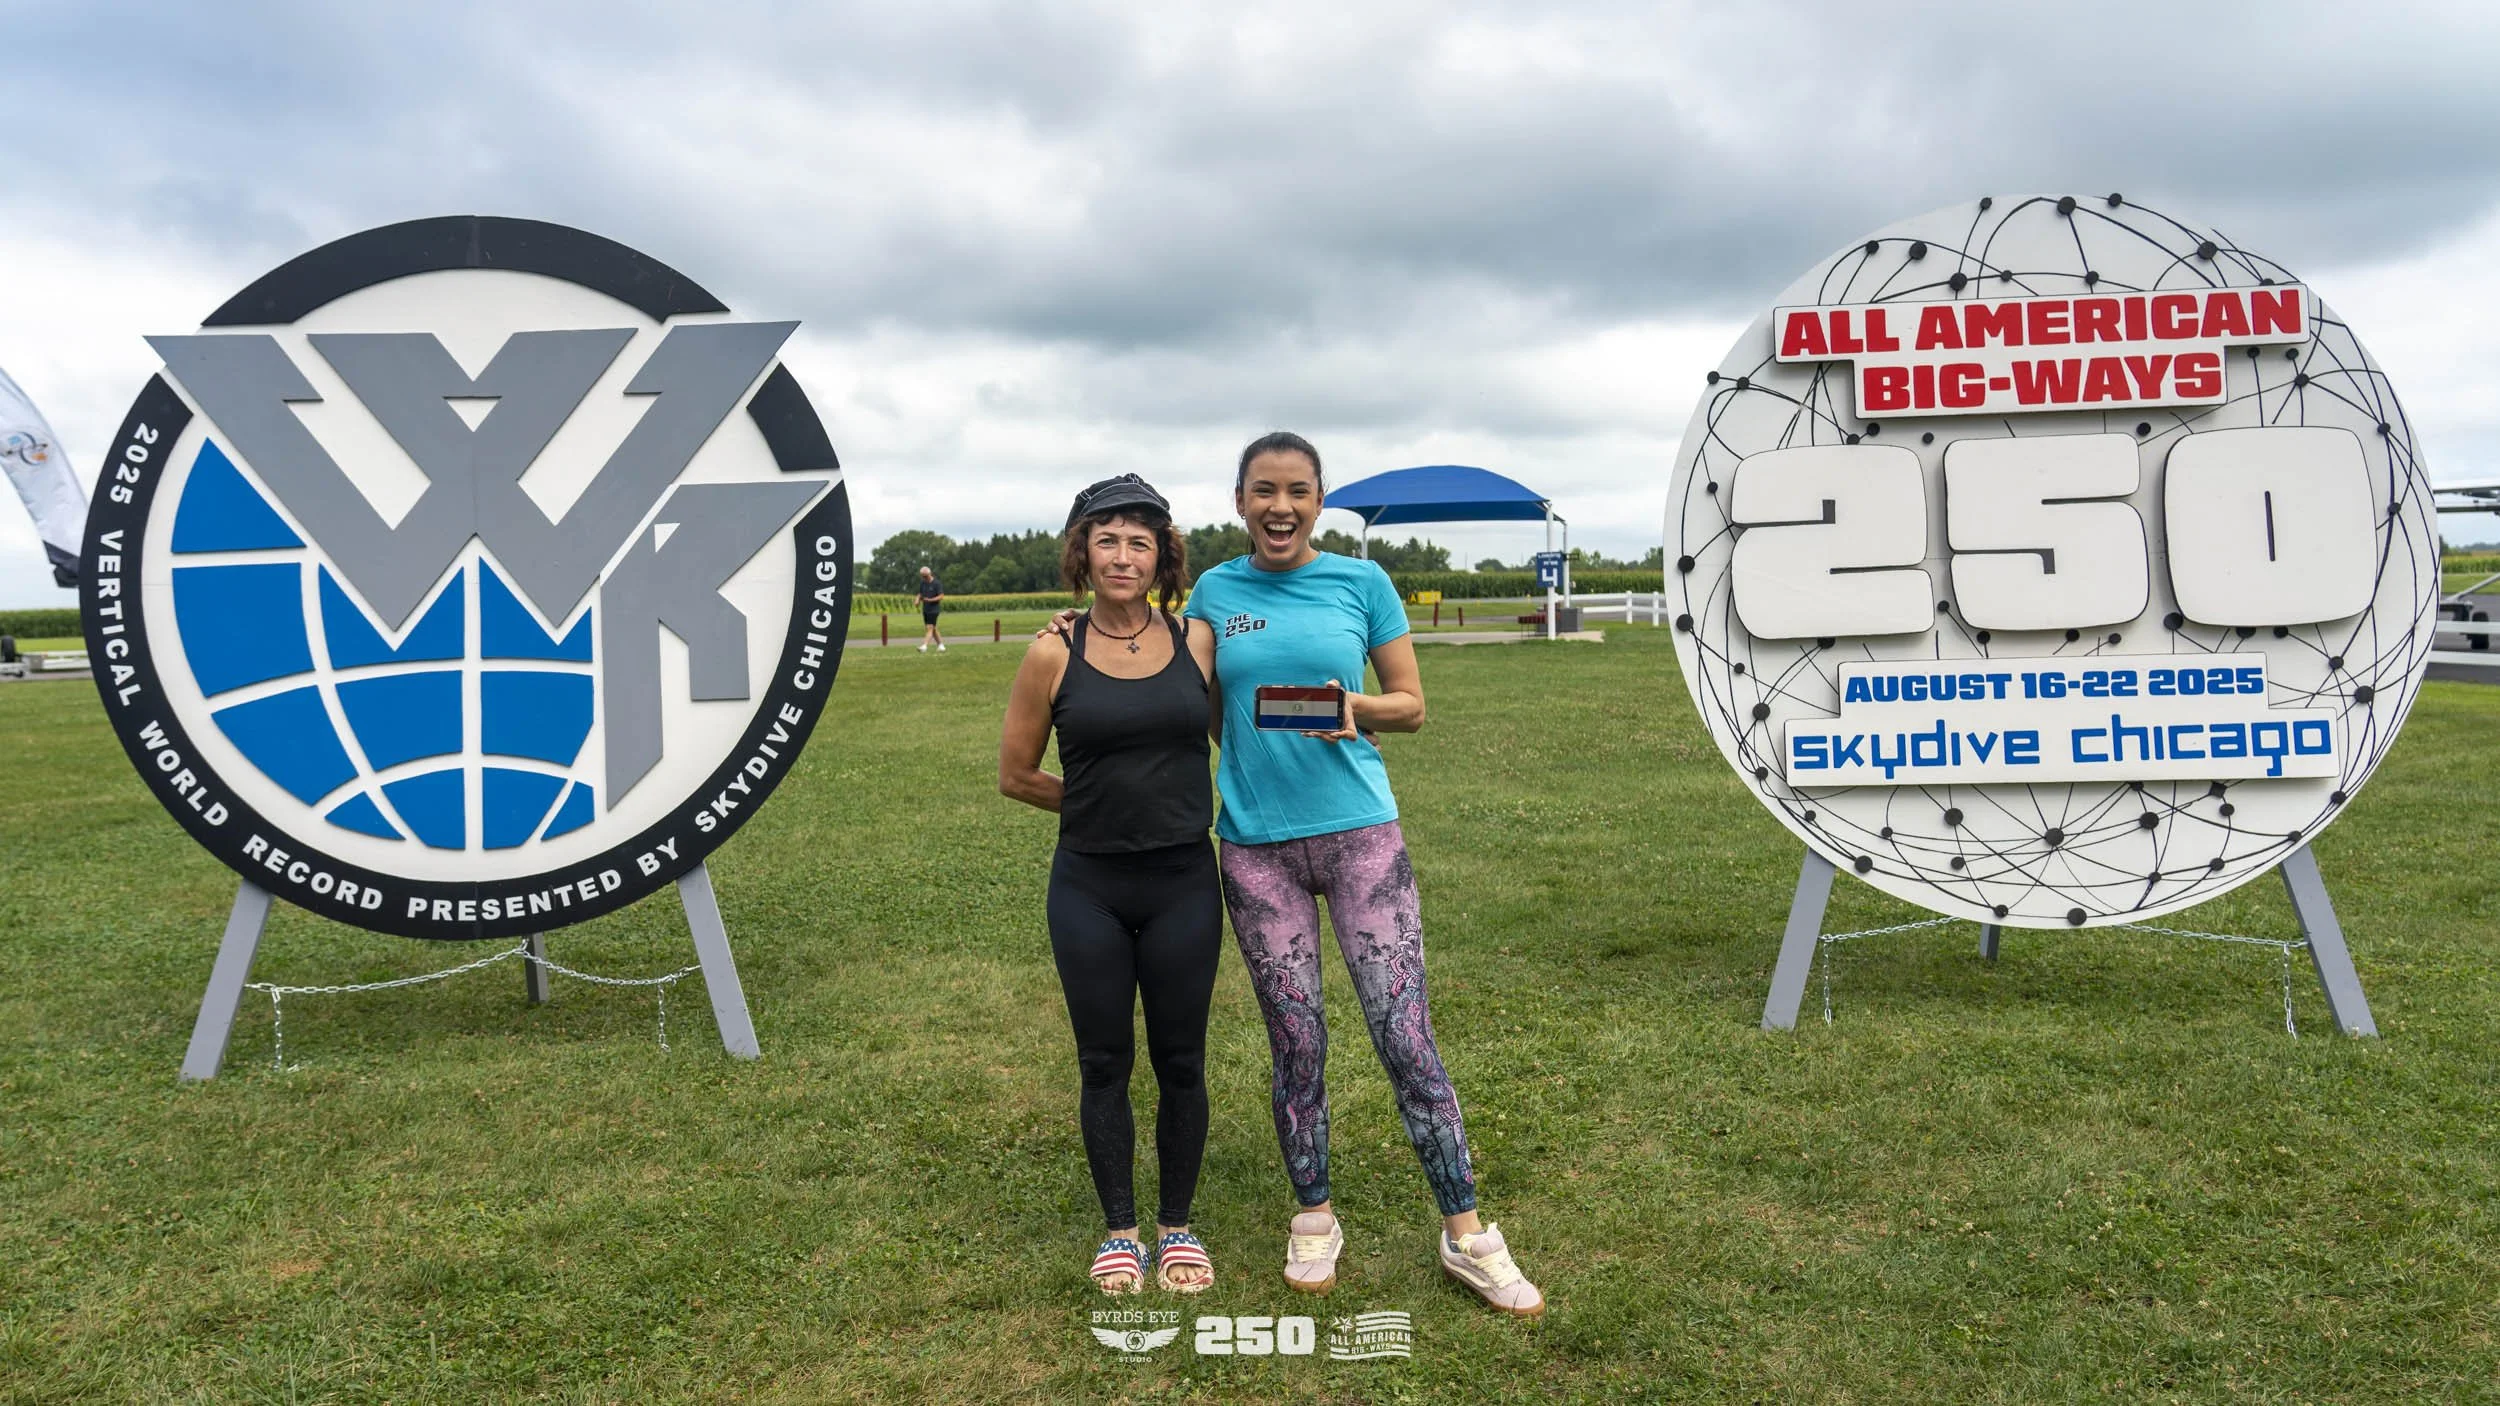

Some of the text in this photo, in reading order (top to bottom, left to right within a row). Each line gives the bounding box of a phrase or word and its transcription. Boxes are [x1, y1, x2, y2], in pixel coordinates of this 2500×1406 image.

[1781, 289, 2302, 357] ALL AMERICAN
[1863, 352, 2223, 411] BIG-WAYS
[1730, 424, 2380, 642] 250
[1541, 567, 1558, 587] 4
[1224, 618, 1266, 639] 250
[1225, 612, 1251, 626] THE
[97, 421, 838, 922] 2025 VERTICAL WORLD RECORD PRESENTED BY SKYDIVE CHICAGO
[1844, 667, 2265, 704] AUGUST 16-22 2025
